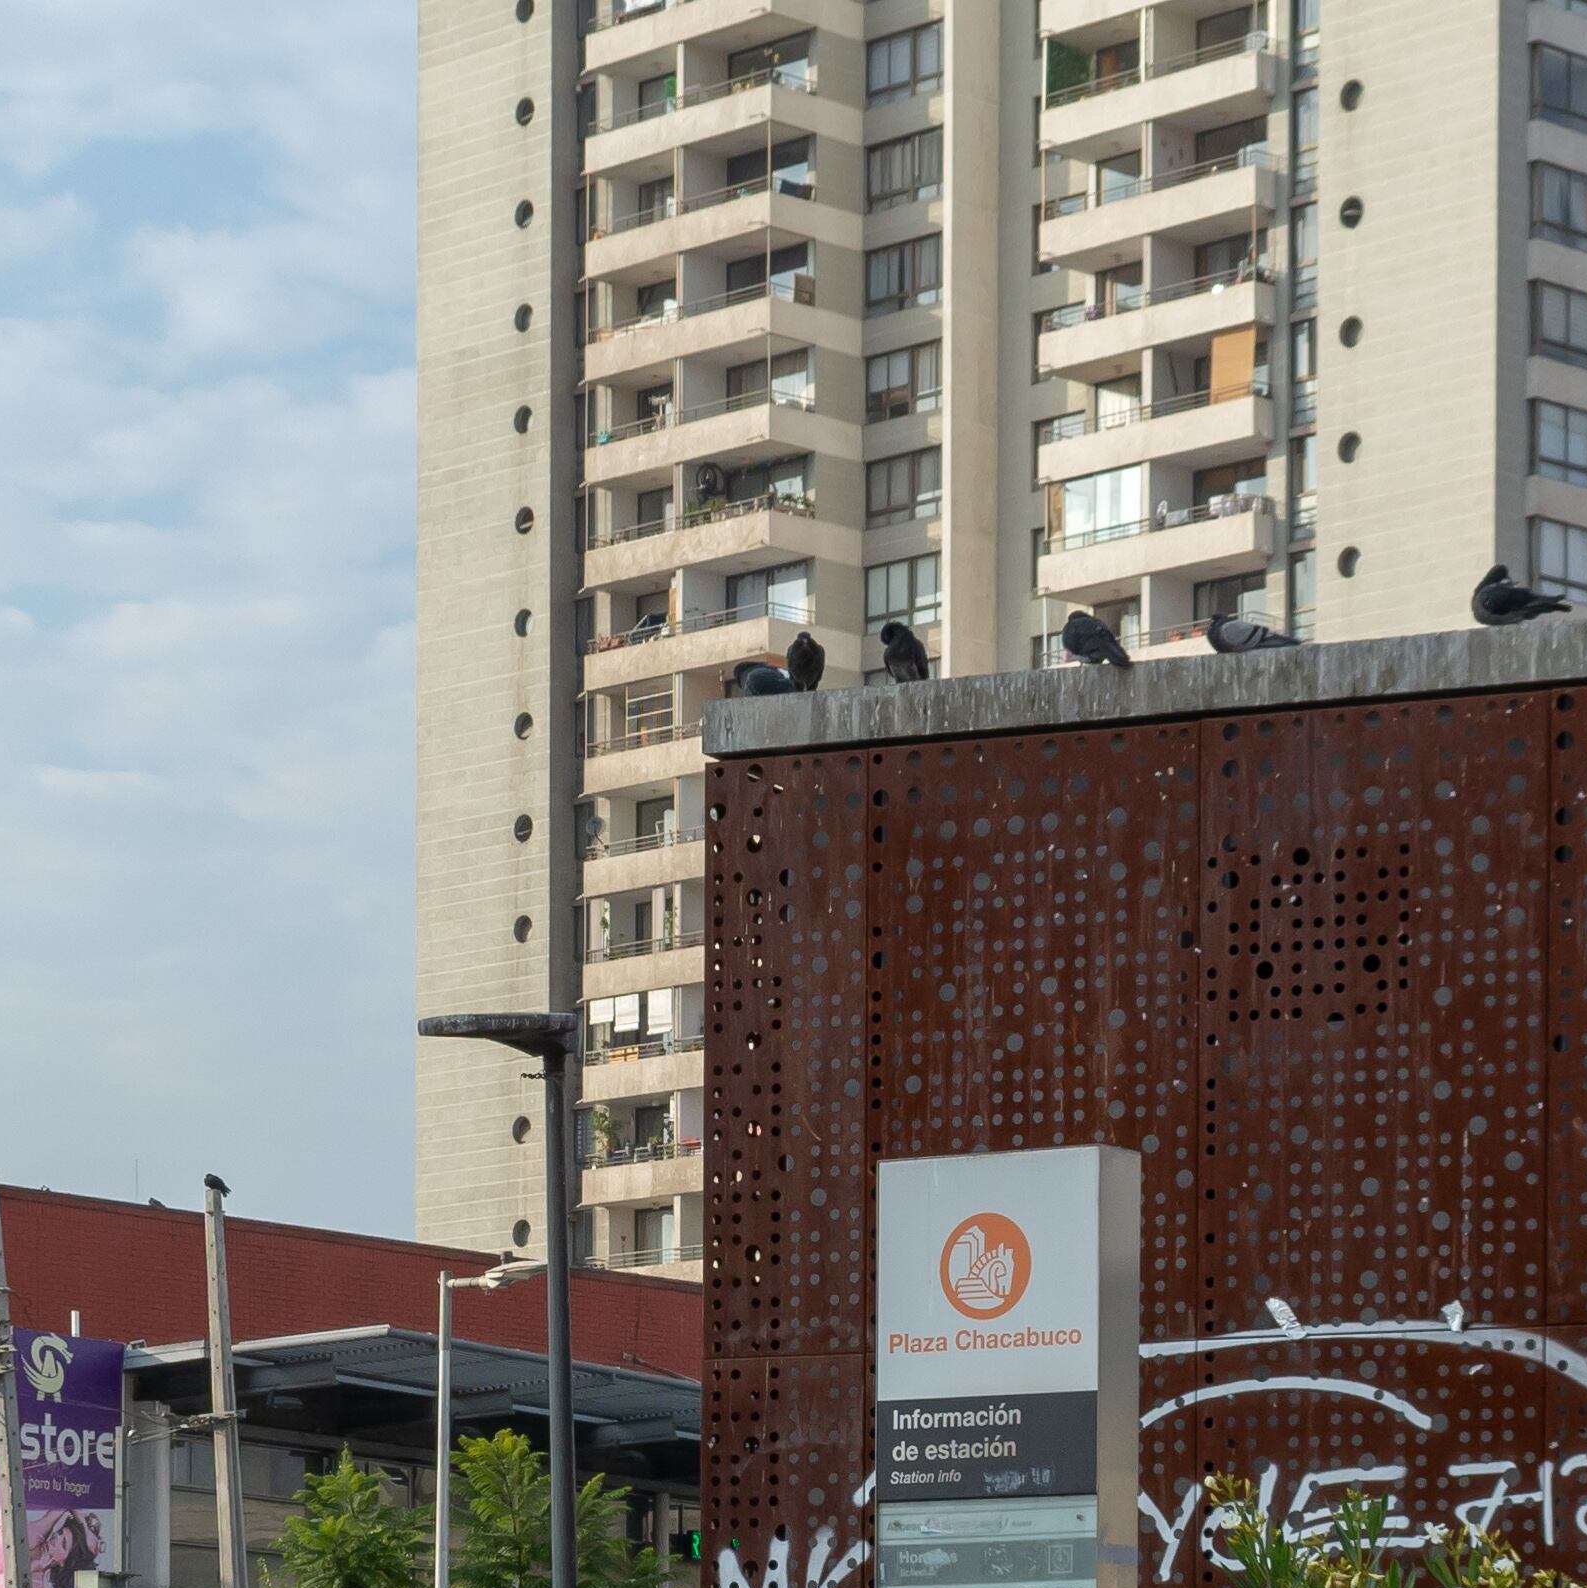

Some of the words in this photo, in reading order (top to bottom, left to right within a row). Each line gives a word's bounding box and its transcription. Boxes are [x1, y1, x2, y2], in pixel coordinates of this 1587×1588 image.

[888, 1332, 948, 1354] Plaza
[954, 1325, 1083, 1352] Chacabuco
[892, 1403, 1022, 1431] Información
[20, 1412, 115, 1469] store
[891, 1441, 919, 1462] de
[924, 1435, 1017, 1461] estación
[889, 1469, 935, 1485] Station
[937, 1468, 962, 1484] info
